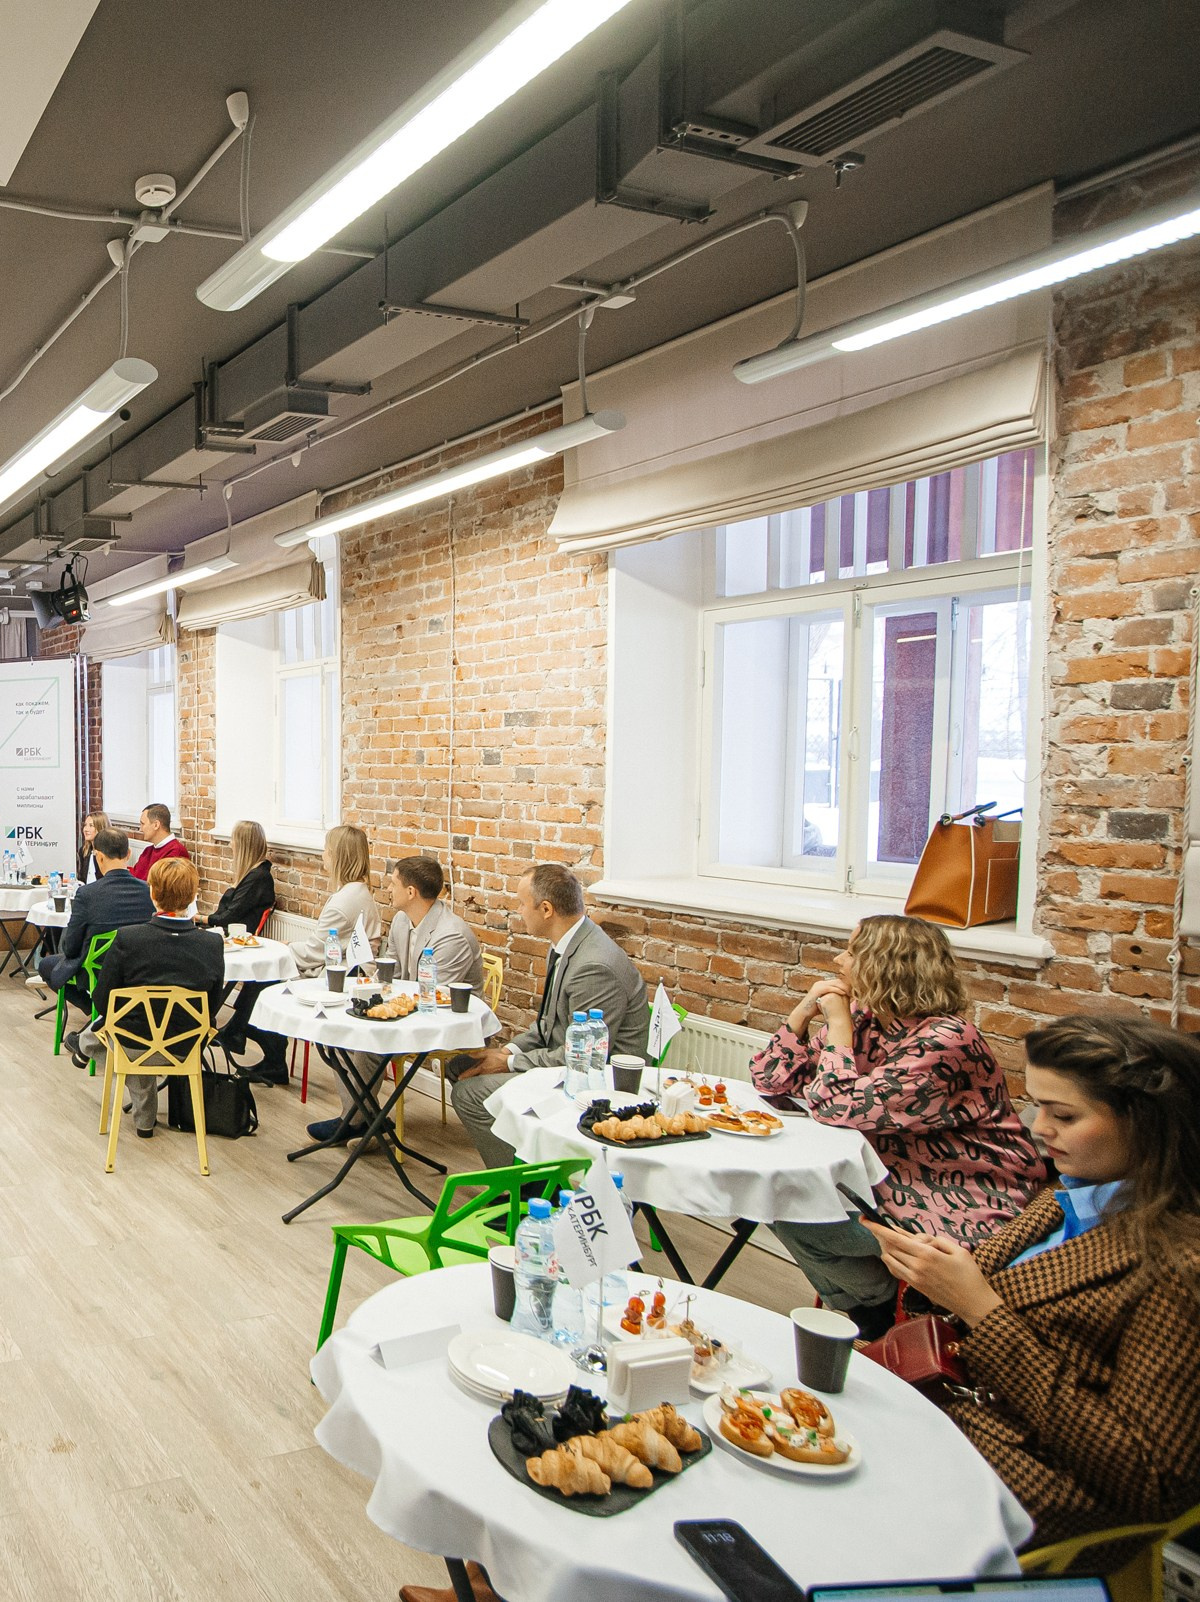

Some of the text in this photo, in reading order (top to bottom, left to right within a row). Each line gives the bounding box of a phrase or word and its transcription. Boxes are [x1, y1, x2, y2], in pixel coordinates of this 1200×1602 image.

[24, 747, 42, 756] РБК
[17, 827, 44, 839] РБК
[574, 1194, 608, 1242] РБК
[567, 1202, 597, 1267] КАТЕРИНБУРГ
